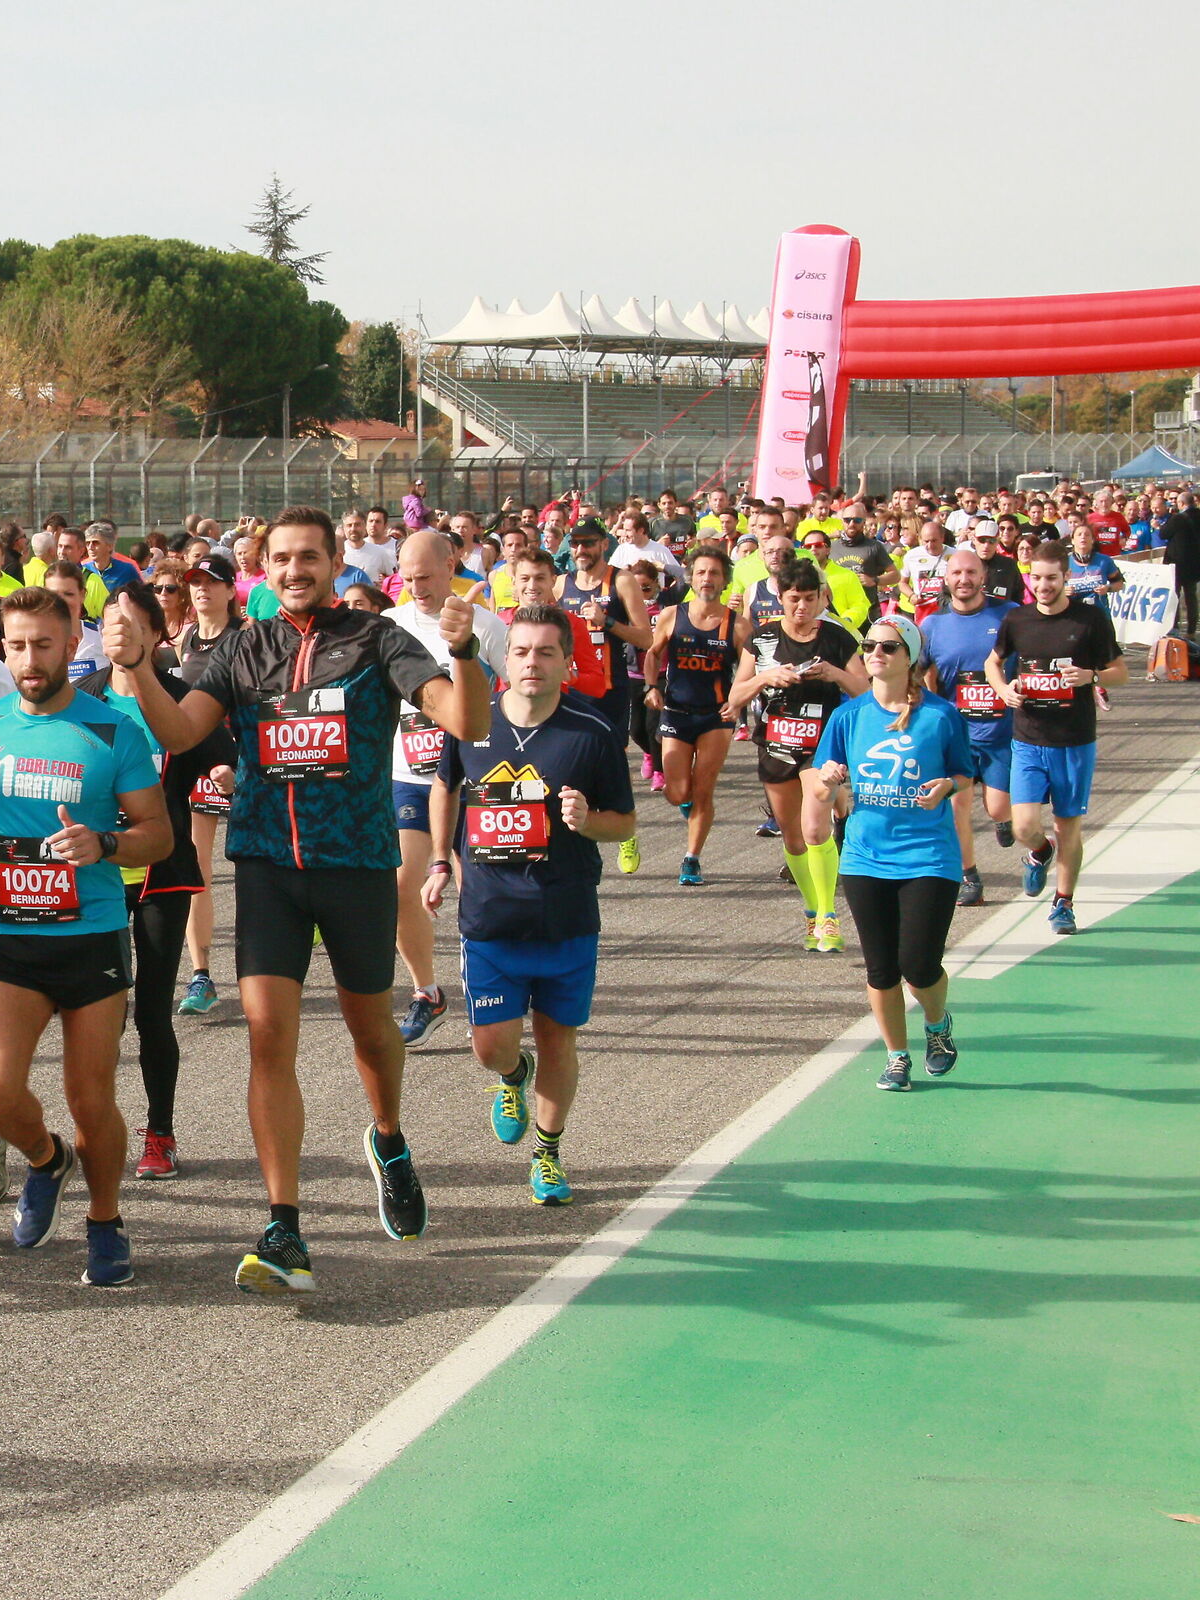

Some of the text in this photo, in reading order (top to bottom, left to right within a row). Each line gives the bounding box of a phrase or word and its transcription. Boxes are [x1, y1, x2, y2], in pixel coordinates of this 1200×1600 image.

[806, 272, 827, 280] asics
[676, 656, 722, 672] ZOLA
[265, 721, 342, 749] 10072
[772, 719, 817, 737] 10128
[405, 731, 445, 752] 1006
[277, 749, 329, 761] LEONARDO
[16, 758, 85, 779] CORLEONE
[856, 782, 926, 798] TRIATHLON
[858, 793, 921, 808] PERSICET
[480, 809, 532, 832] 803
[497, 834, 524, 843] DAVID
[2, 867, 71, 893] 10074
[10, 893, 60, 905] BERNARDO
[475, 995, 504, 1008] Royal
